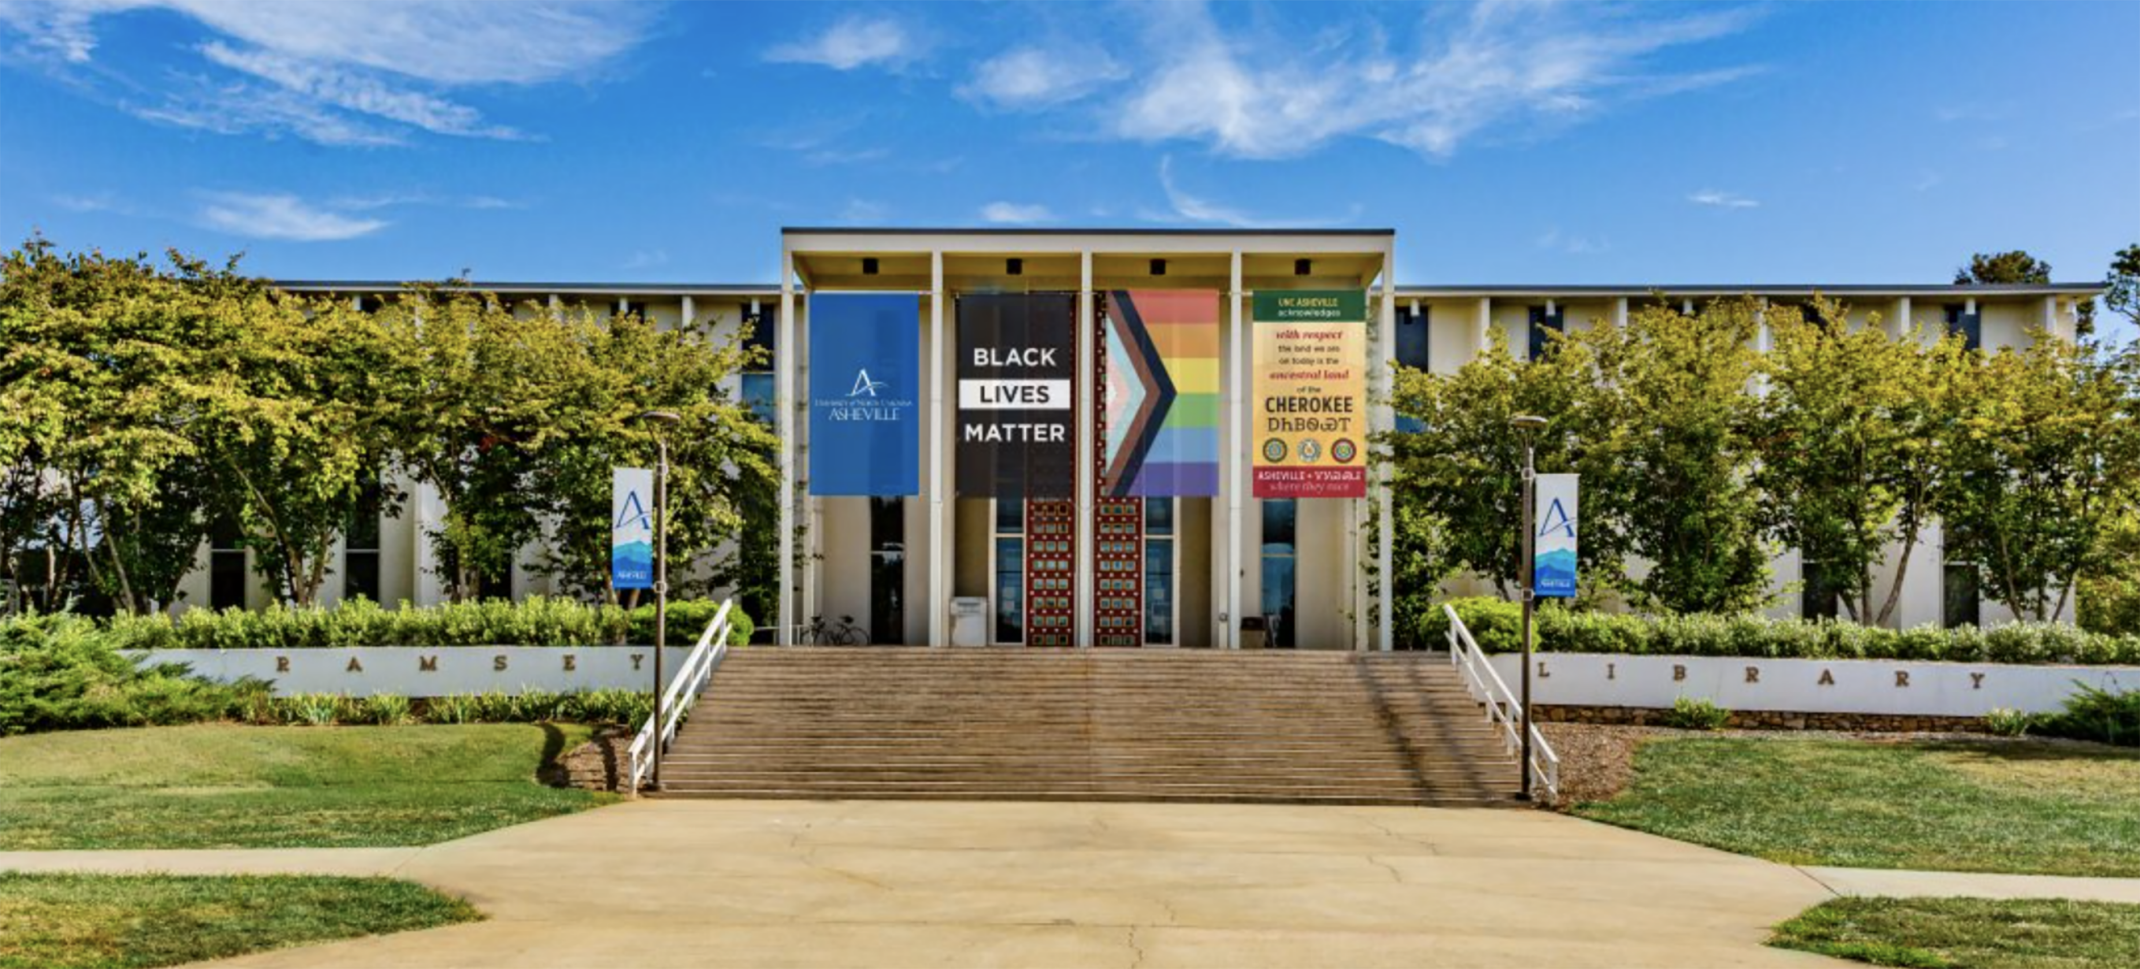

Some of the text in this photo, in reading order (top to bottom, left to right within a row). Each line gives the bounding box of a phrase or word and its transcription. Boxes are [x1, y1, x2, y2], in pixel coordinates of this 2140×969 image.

[1278, 297, 1338, 307] UNC ASHEVILLE
[1277, 308, 1341, 318] acknowledges
[1276, 329, 1343, 342] with respect
[973, 347, 1057, 367] BLACK
[1292, 357, 1315, 366] today
[1326, 357, 1339, 365] the
[1269, 369, 1349, 380] ancestral land
[979, 385, 1051, 403] LIVES
[1308, 385, 1322, 393] the
[1265, 396, 1353, 413] CHEROKEE
[828, 407, 901, 421] ASHEVILLE
[964, 423, 1066, 442] MATTER
[1258, 470, 1305, 481] ASHEVILLE
[276, 653, 645, 673] RAMSEY
[1537, 661, 1986, 690] LIBRARY
